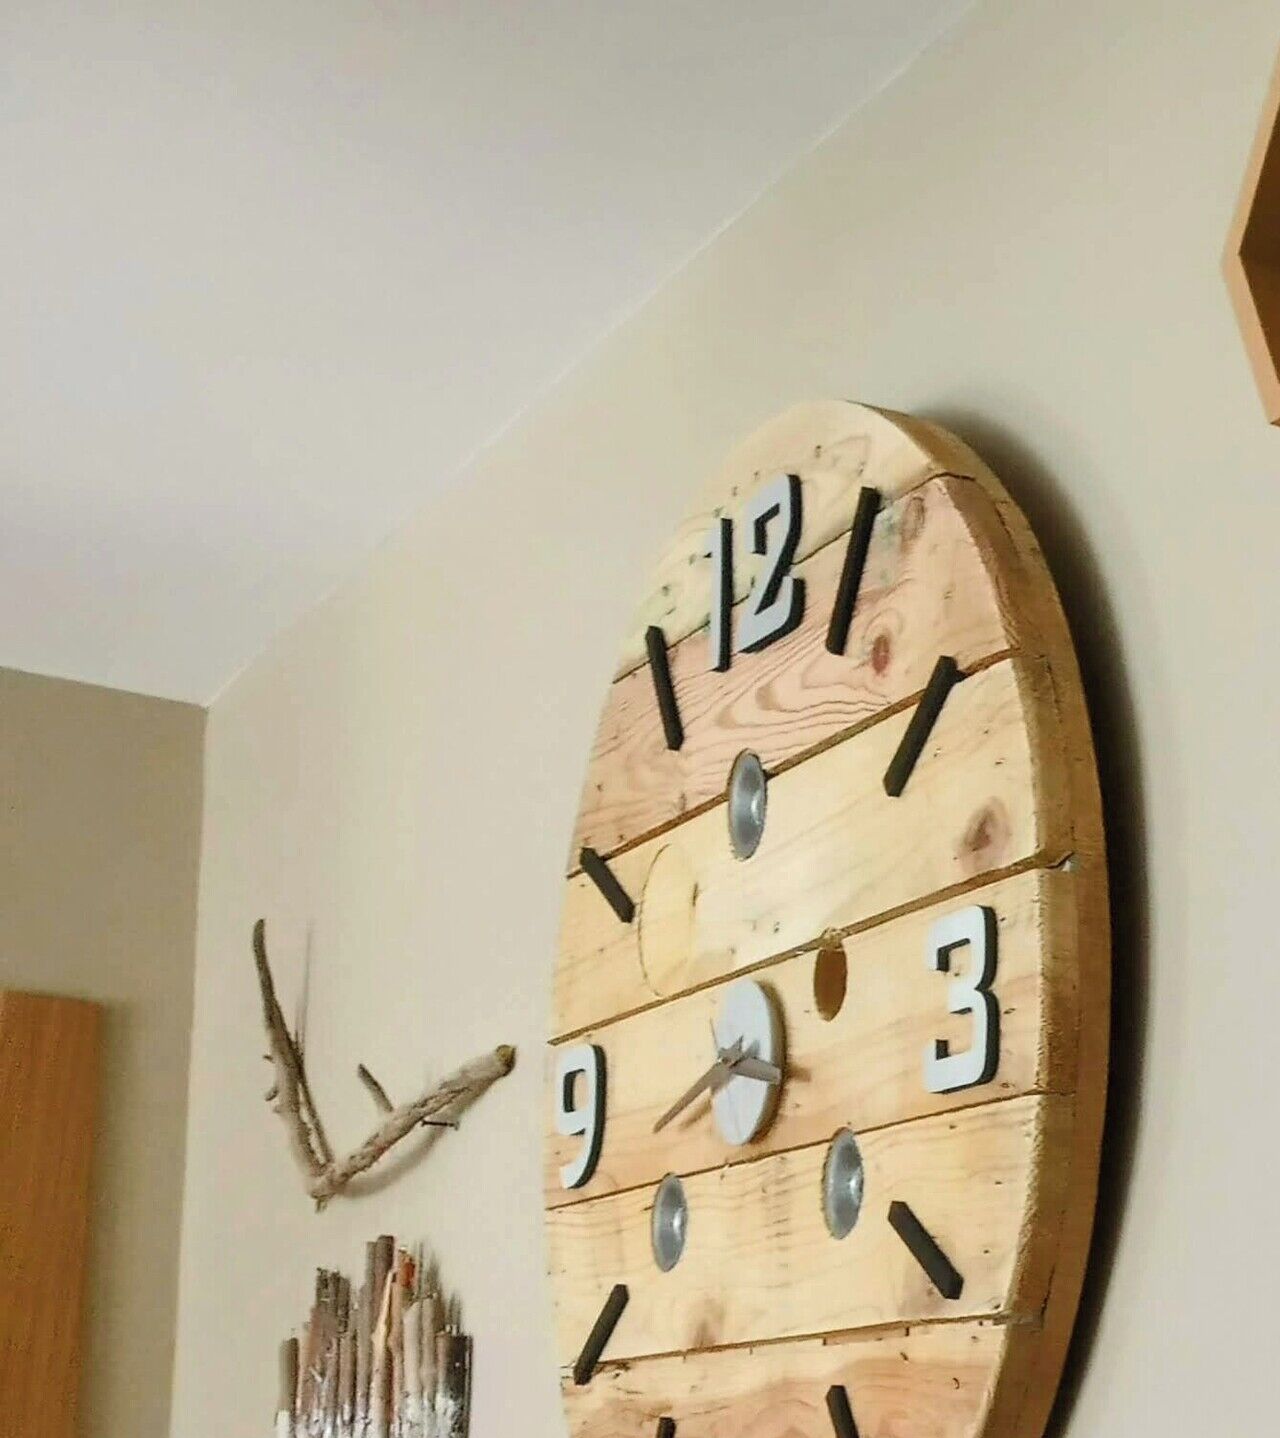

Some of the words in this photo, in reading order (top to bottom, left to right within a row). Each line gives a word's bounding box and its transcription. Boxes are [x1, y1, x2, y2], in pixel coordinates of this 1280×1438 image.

[703, 474, 800, 671] 12
[923, 904, 999, 1093] 3
[556, 1041, 605, 1188] 9
